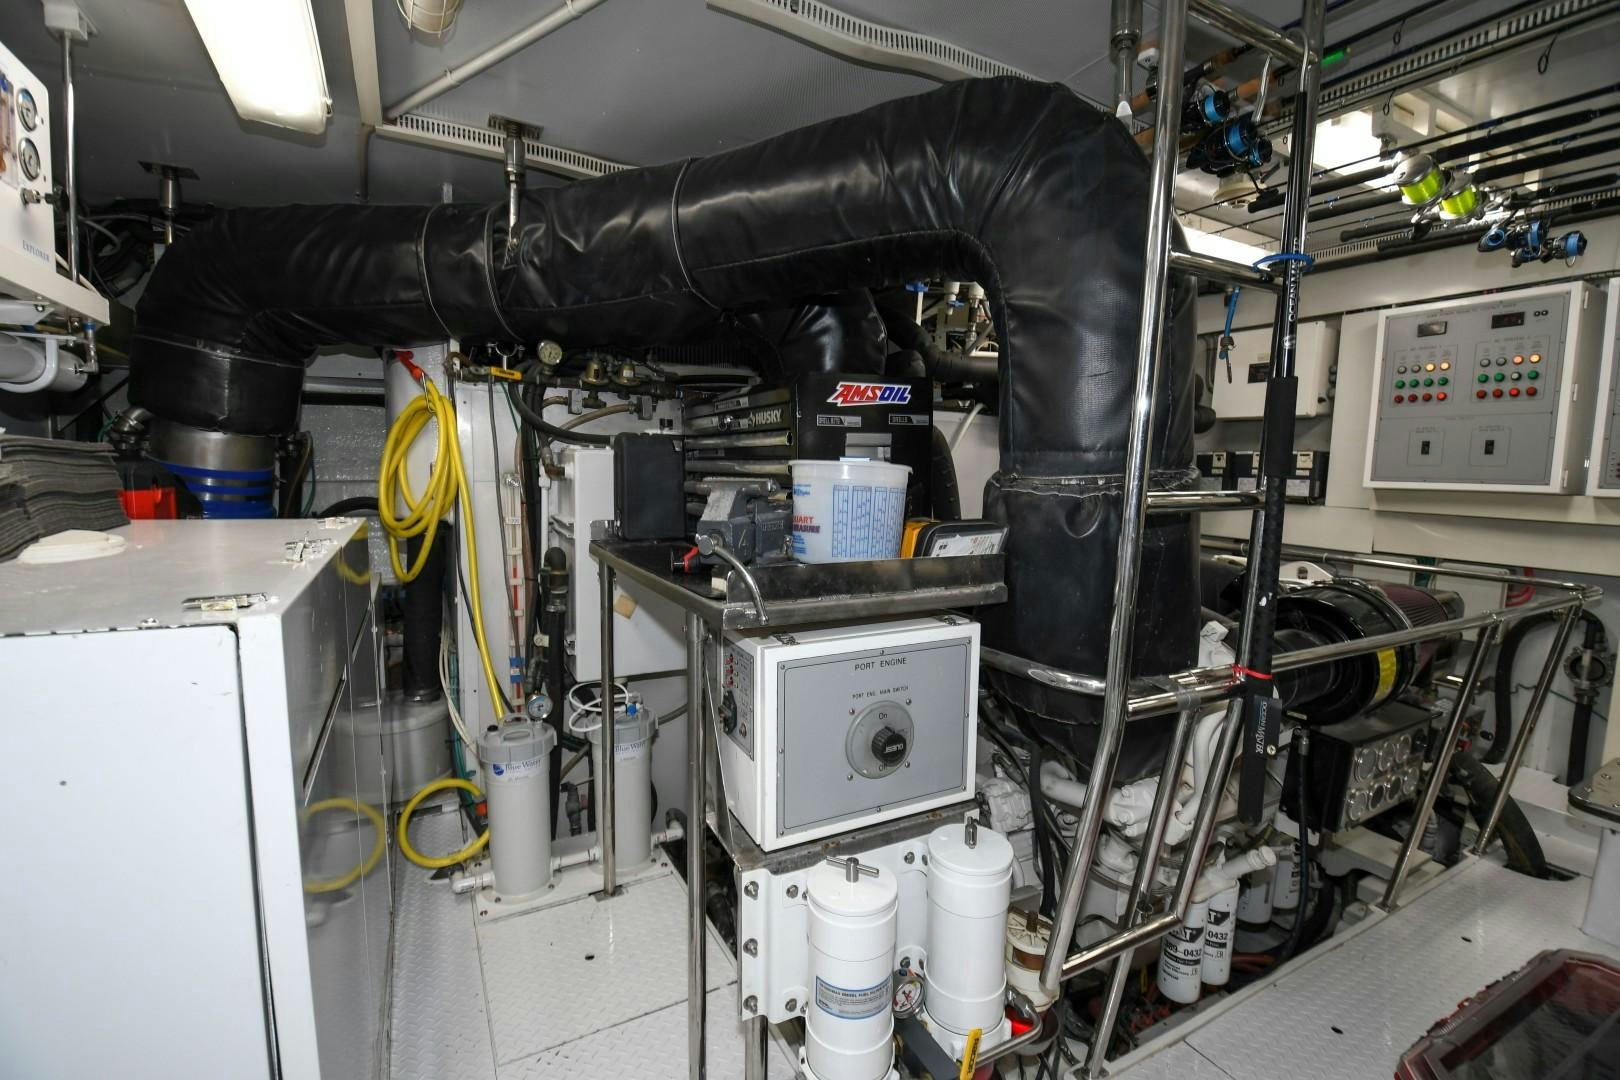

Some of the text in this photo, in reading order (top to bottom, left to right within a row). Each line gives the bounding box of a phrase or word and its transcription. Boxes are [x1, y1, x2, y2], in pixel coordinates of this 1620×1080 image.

[22, 240, 50, 262] EXPLORER
[828, 383, 911, 405] AMSOIL
[755, 409, 782, 426] HUSKY
[792, 515, 814, 525] UART
[854, 657, 907, 671] PORT ENGINE
[878, 712, 888, 720] On
